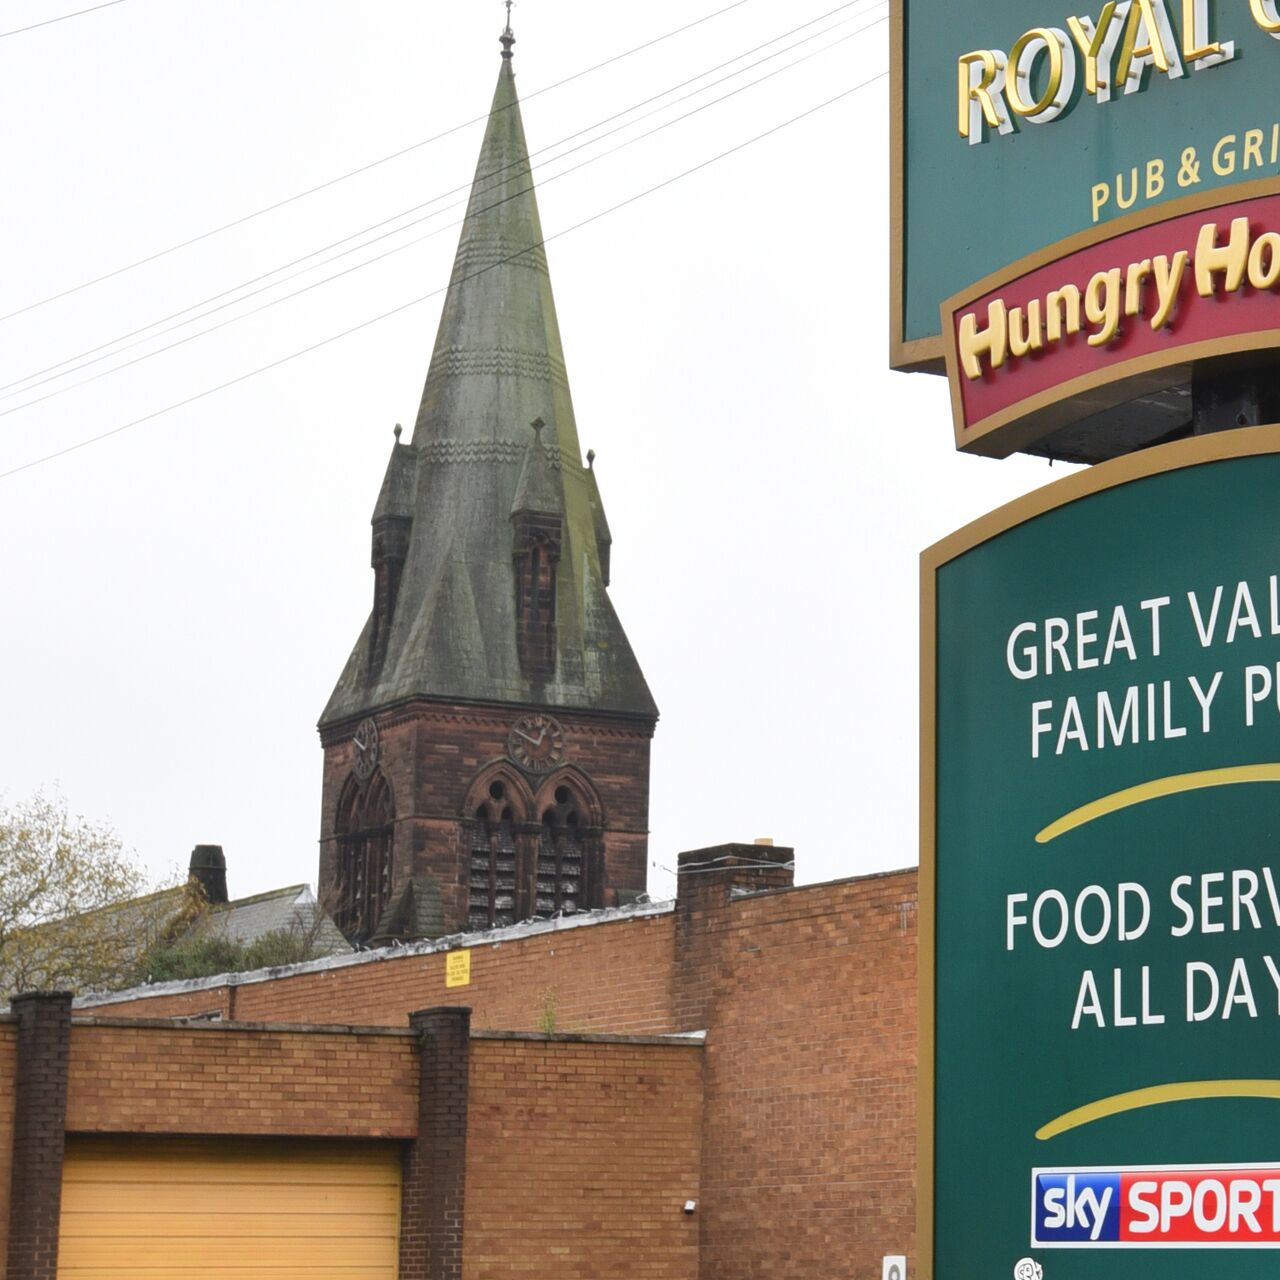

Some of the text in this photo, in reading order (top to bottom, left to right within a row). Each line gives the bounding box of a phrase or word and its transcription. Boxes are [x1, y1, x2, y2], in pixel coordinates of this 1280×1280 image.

[1091, 157, 1165, 222] PUB
[1177, 147, 1201, 185] &
[959, 251, 1187, 379] Hungry
[1006, 596, 1171, 680] GREAT
[1031, 672, 1223, 758] FAMILY
[1006, 881, 1151, 951] FOOD
[1071, 965, 1165, 1030] ALL
[1044, 1174, 1113, 1240] sky
